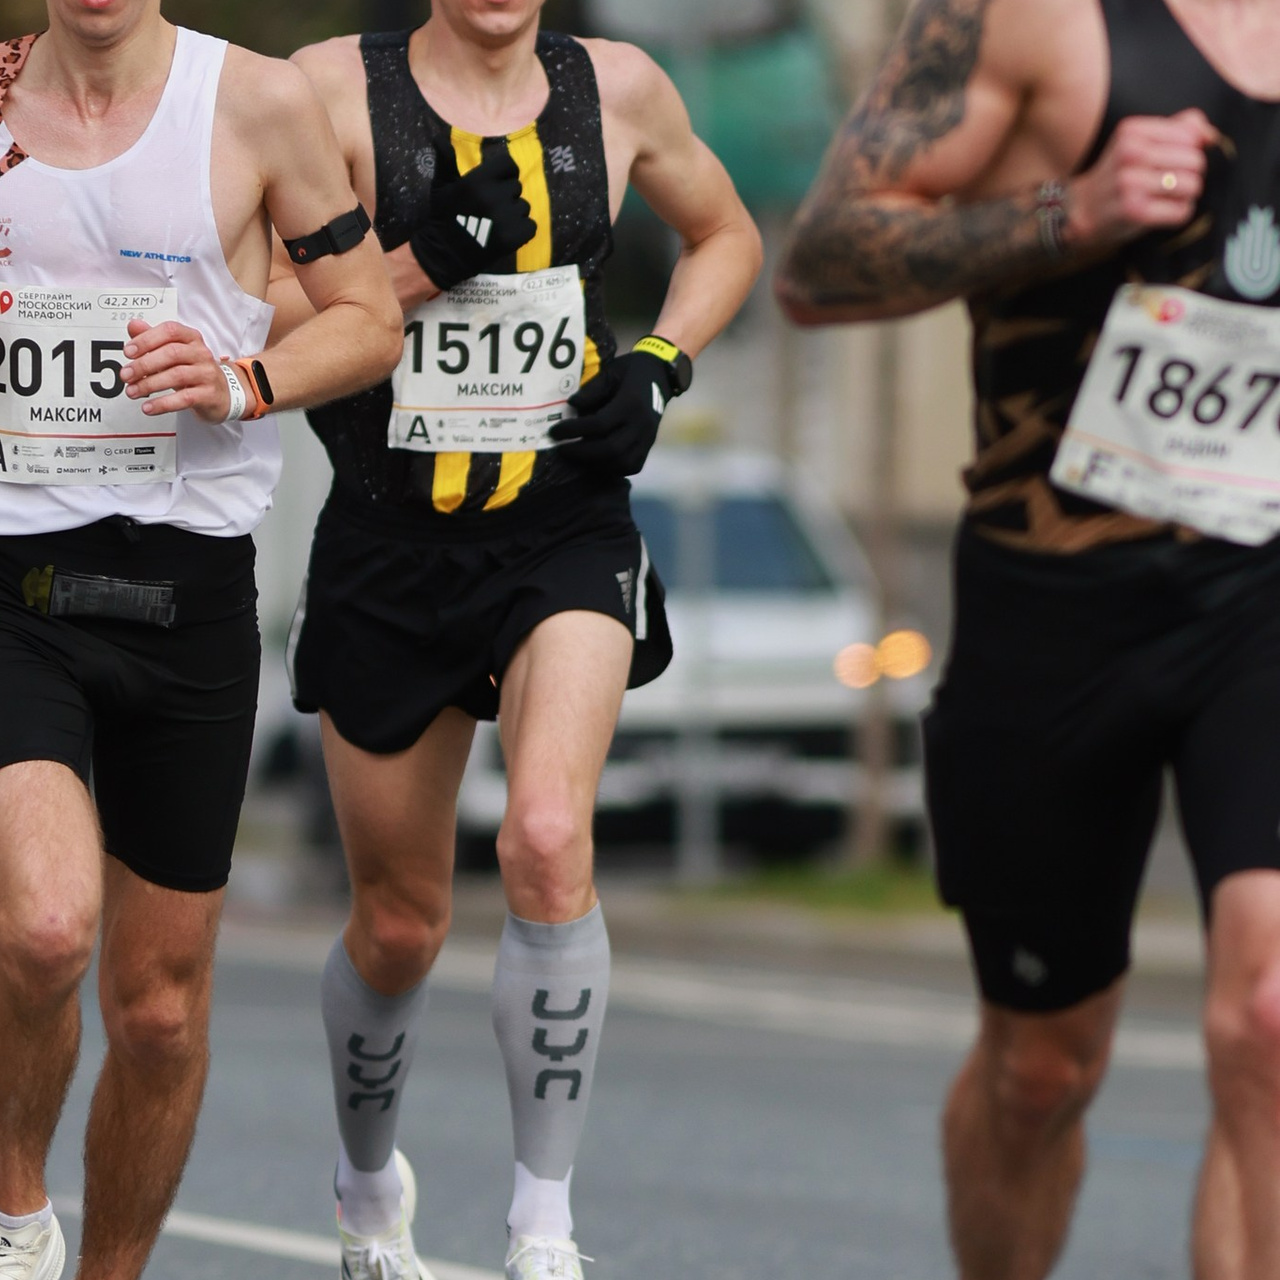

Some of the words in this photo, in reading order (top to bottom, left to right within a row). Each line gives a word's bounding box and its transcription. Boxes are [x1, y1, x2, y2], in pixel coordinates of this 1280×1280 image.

[144, 252, 191, 262] ATHLETICS
[18, 292, 72, 300] СБЕРПРАЙМ
[447, 296, 498, 305] МАРАФОН
[18, 300, 92, 310] МОСКОВСКИЙ
[104, 297, 128, 307] 42,2
[18, 310, 72, 320] МАРАФОН
[404, 316, 576, 374] 15196
[457, 383, 523, 397] МАКСИМ
[1113, 343, 1280, 433] 1867
[30, 407, 102, 422] МАКСИМ
